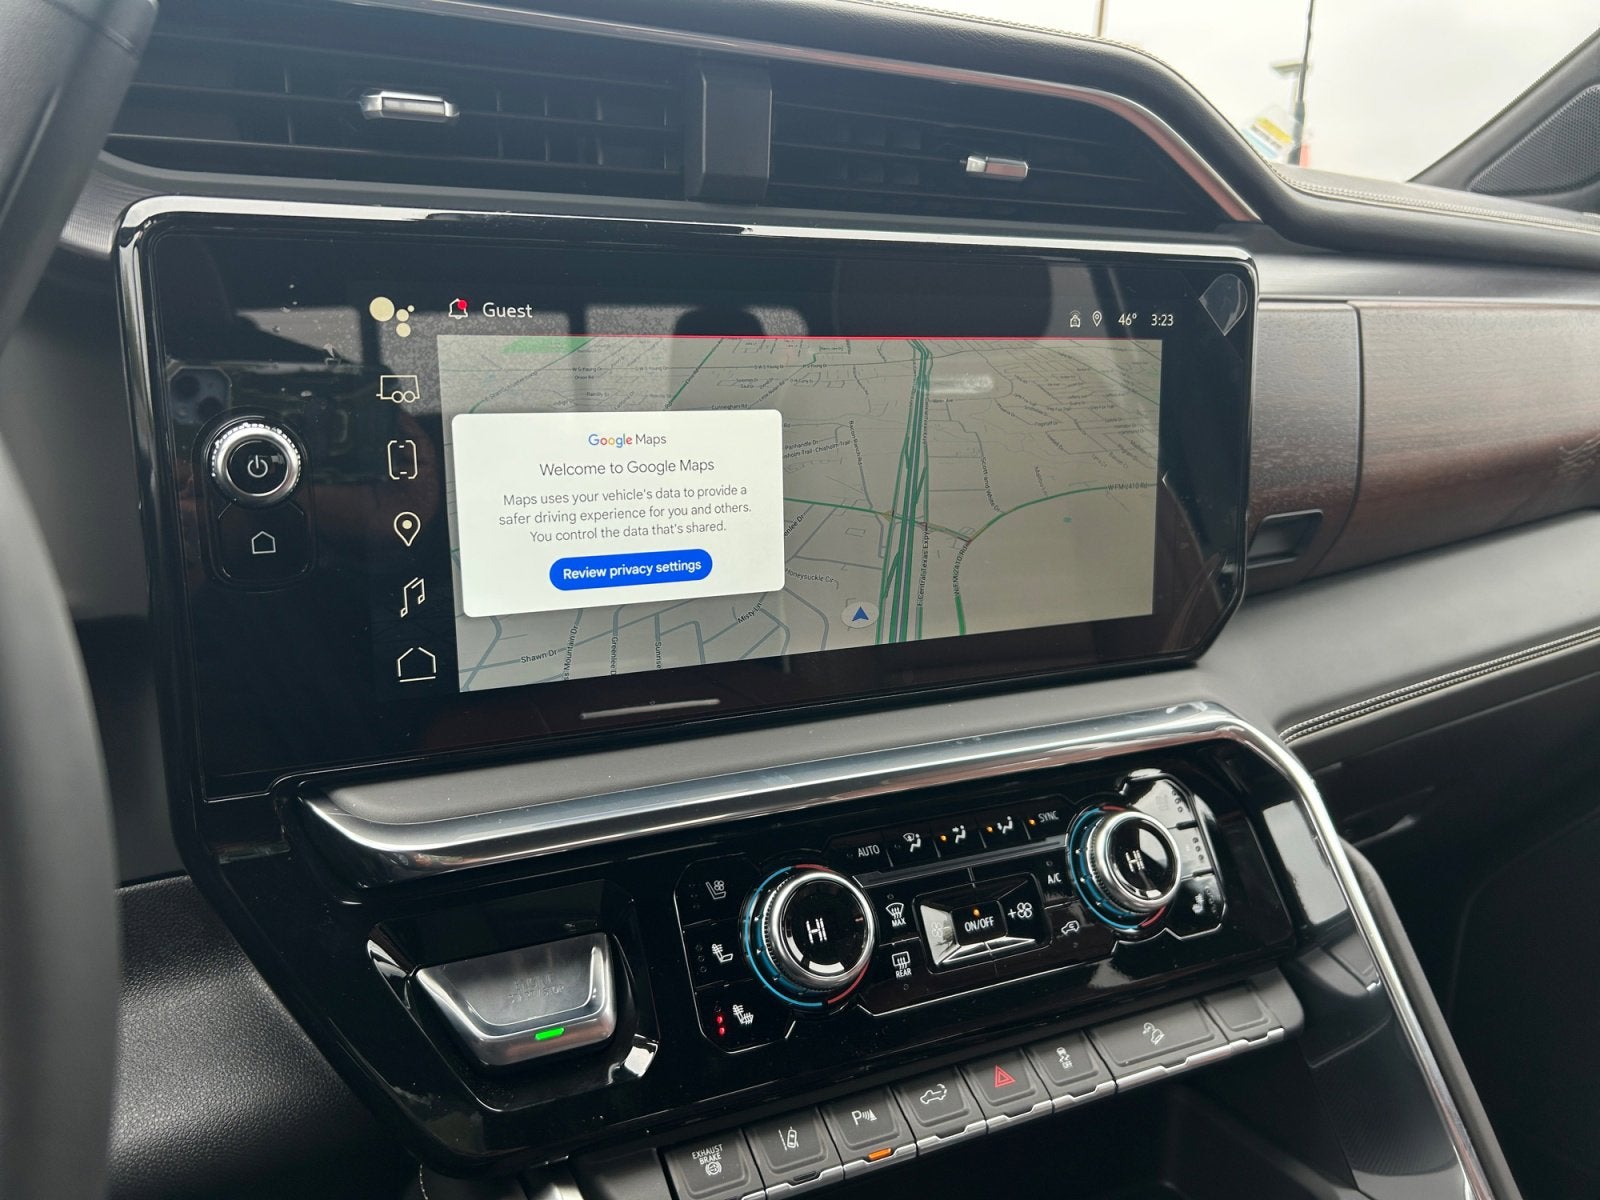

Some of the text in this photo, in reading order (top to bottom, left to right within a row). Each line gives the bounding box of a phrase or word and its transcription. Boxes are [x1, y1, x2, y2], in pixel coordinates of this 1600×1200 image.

[482, 302, 533, 318] Guest
[1118, 313, 1137, 326] 46°
[1151, 314, 1174, 326] 3:23
[588, 433, 667, 448] Google Maps
[539, 459, 715, 476] Welcome to Google Maps
[503, 484, 748, 508] Maps uses your vehicle's data to provide a
[499, 502, 752, 526] safer driving experience for you and others.
[530, 519, 727, 543] You control the data that's shared.
[563, 559, 702, 580] Review privacy settings
[563, 634, 576, 671] Mountain
[570, 624, 578, 635] Dr
[520, 649, 558, 664] Shawn Dr
[1037, 810, 1060, 823] SYNC
[857, 844, 880, 858] AUTO
[1046, 874, 1062, 885] A/C
[891, 917, 906, 927] MAX
[964, 916, 994, 933] ON/OFF
[805, 917, 828, 945] HI
[895, 967, 912, 978] REAR
[692, 1143, 724, 1161] EXHAUST
[698, 1151, 722, 1166] BRAKE
